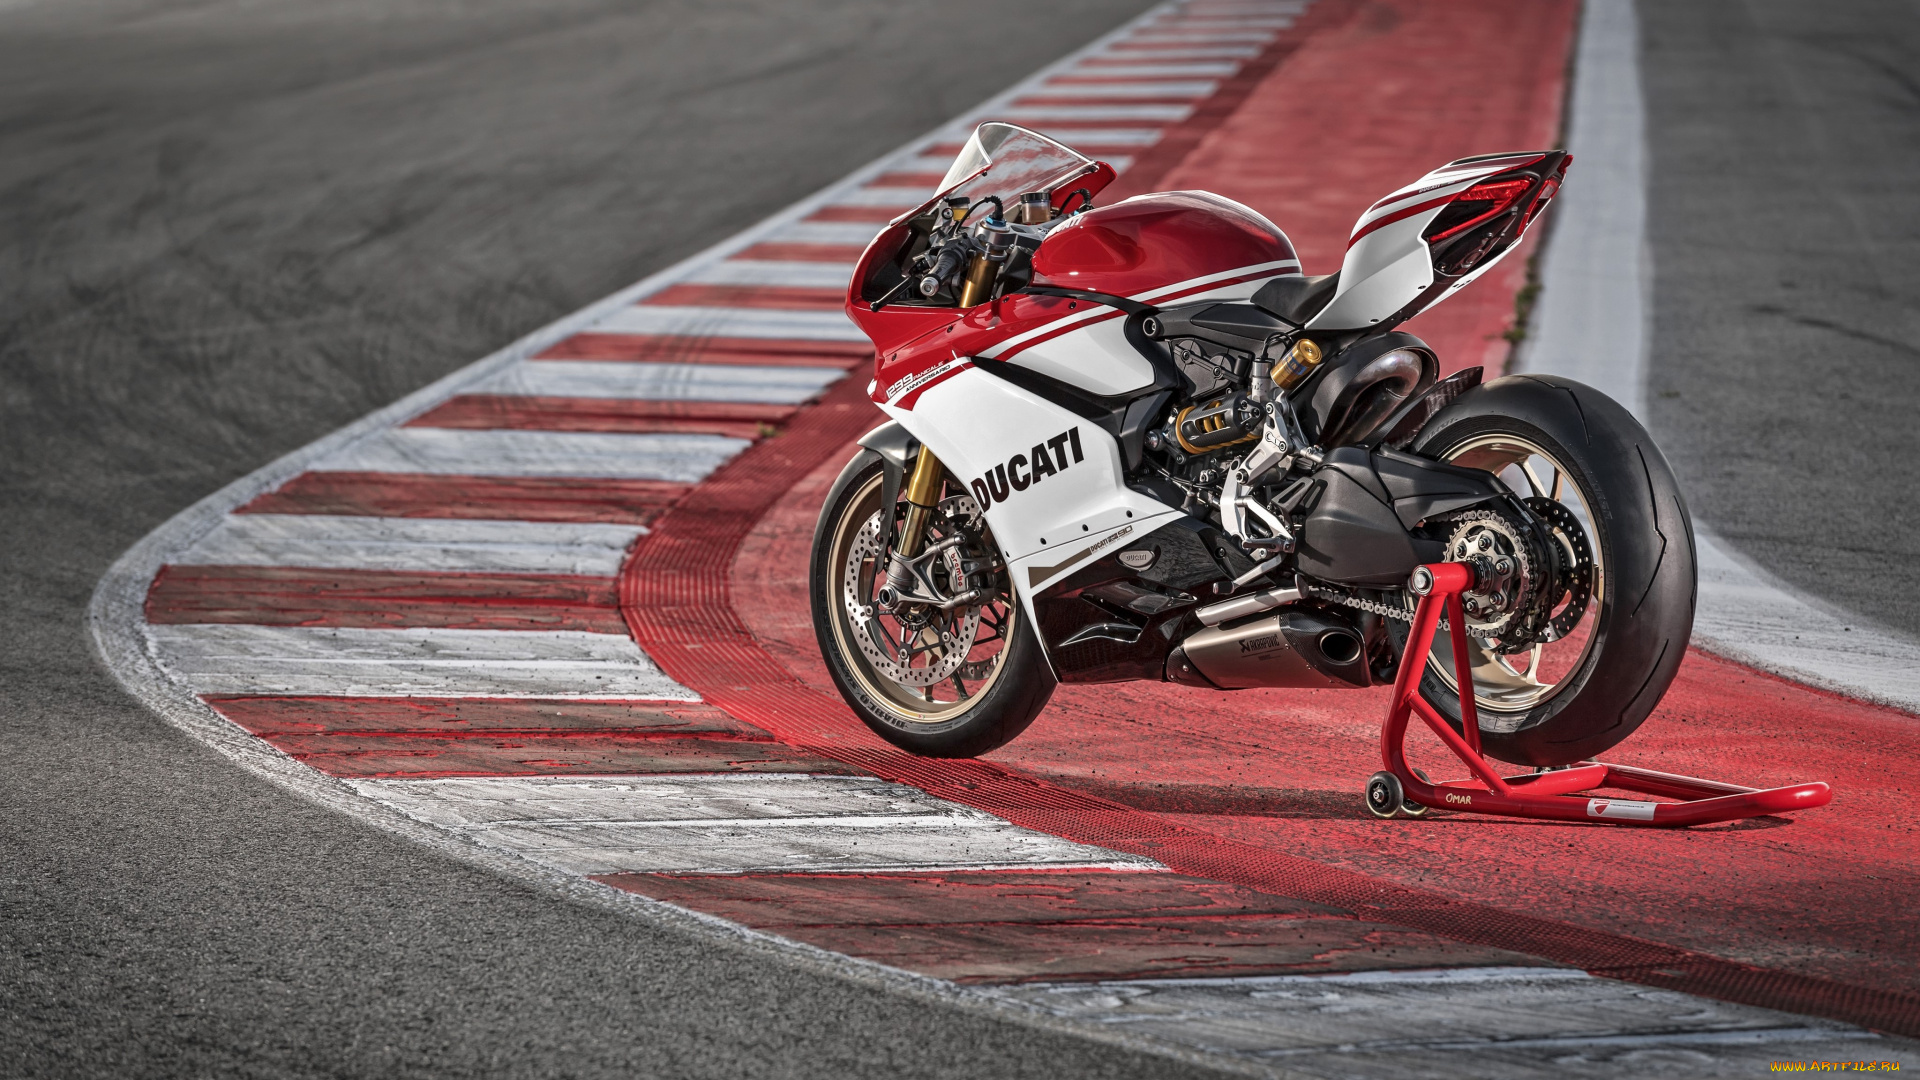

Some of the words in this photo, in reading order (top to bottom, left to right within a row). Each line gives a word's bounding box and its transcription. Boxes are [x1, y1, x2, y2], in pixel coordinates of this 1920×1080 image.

[970, 426, 1084, 513] DUCATI
[951, 552, 964, 587] brembo
[859, 694, 907, 729] DIABLO
[1445, 792, 1472, 805] OMAR
